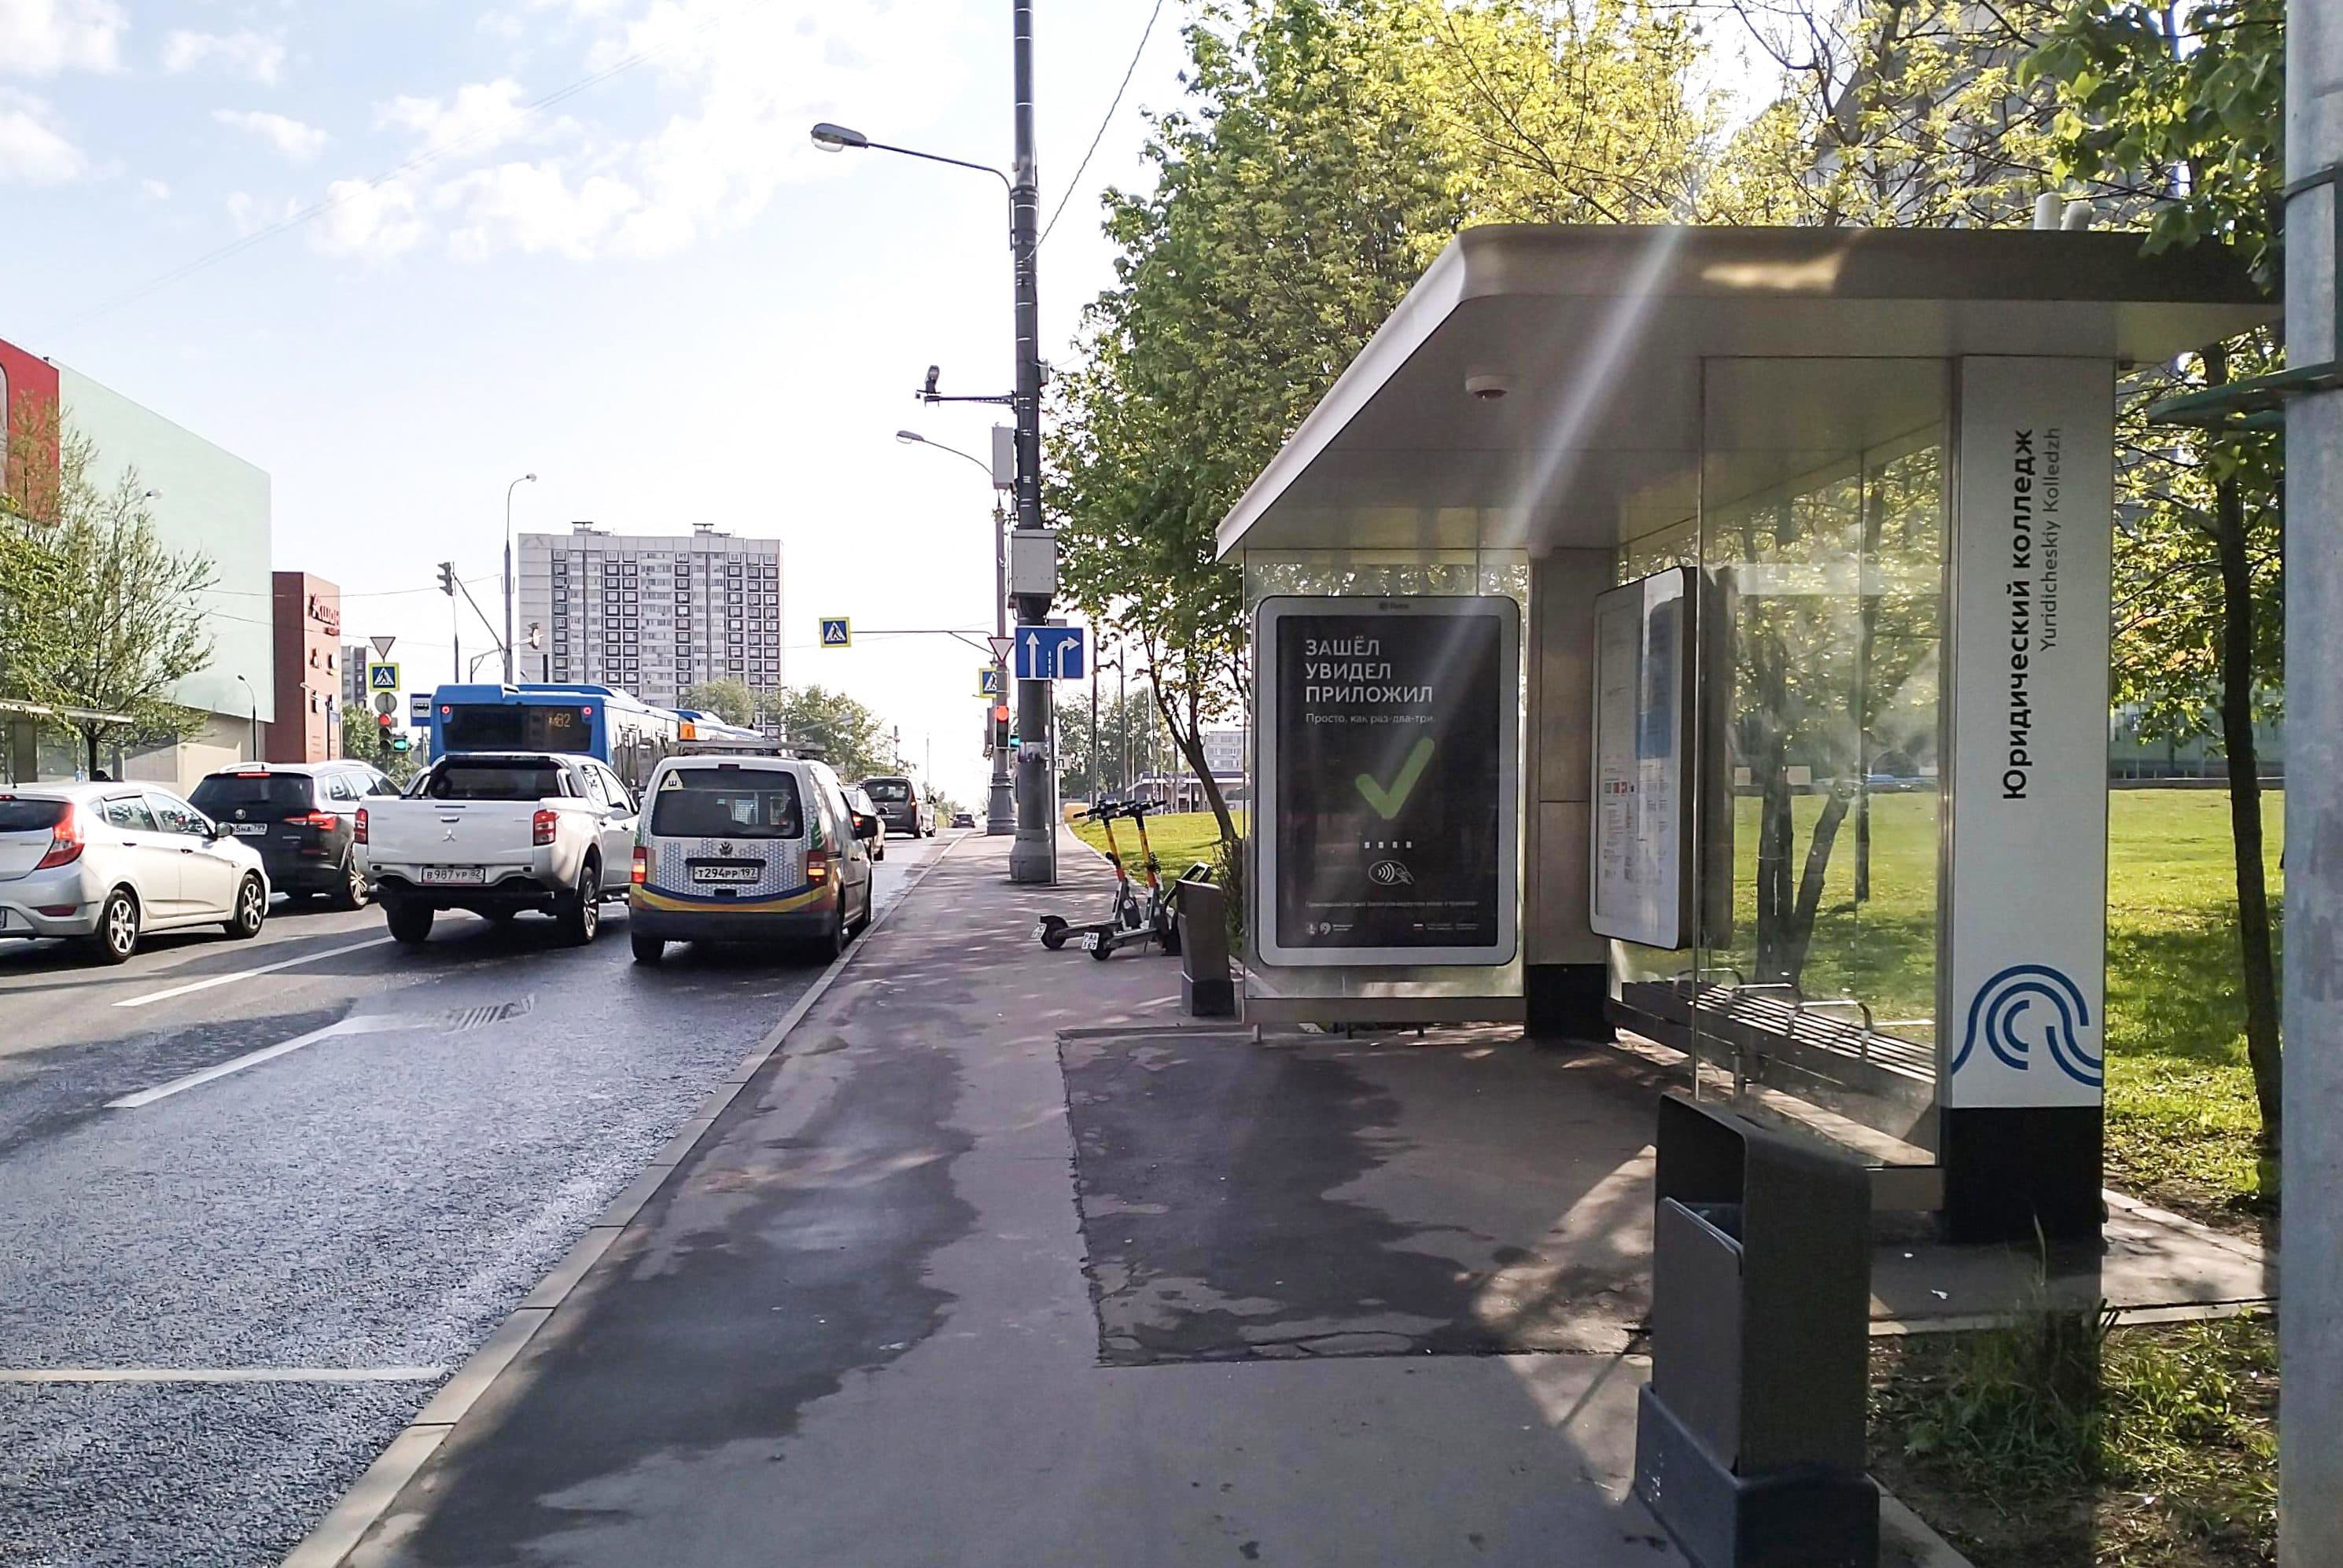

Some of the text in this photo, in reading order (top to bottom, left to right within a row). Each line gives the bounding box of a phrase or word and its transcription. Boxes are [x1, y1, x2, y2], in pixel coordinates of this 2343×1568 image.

[2039, 427, 2062, 653] Yuridicheskiy Kolledzh
[2002, 428, 2036, 801] Юридический колледж
[1305, 635, 1380, 656] ЗАШЁЛ
[1305, 662, 1391, 683] УВИДЕЛ
[1305, 686, 1433, 703] ПРИЛОЖИЛ
[1306, 712, 1348, 724] Просто,
